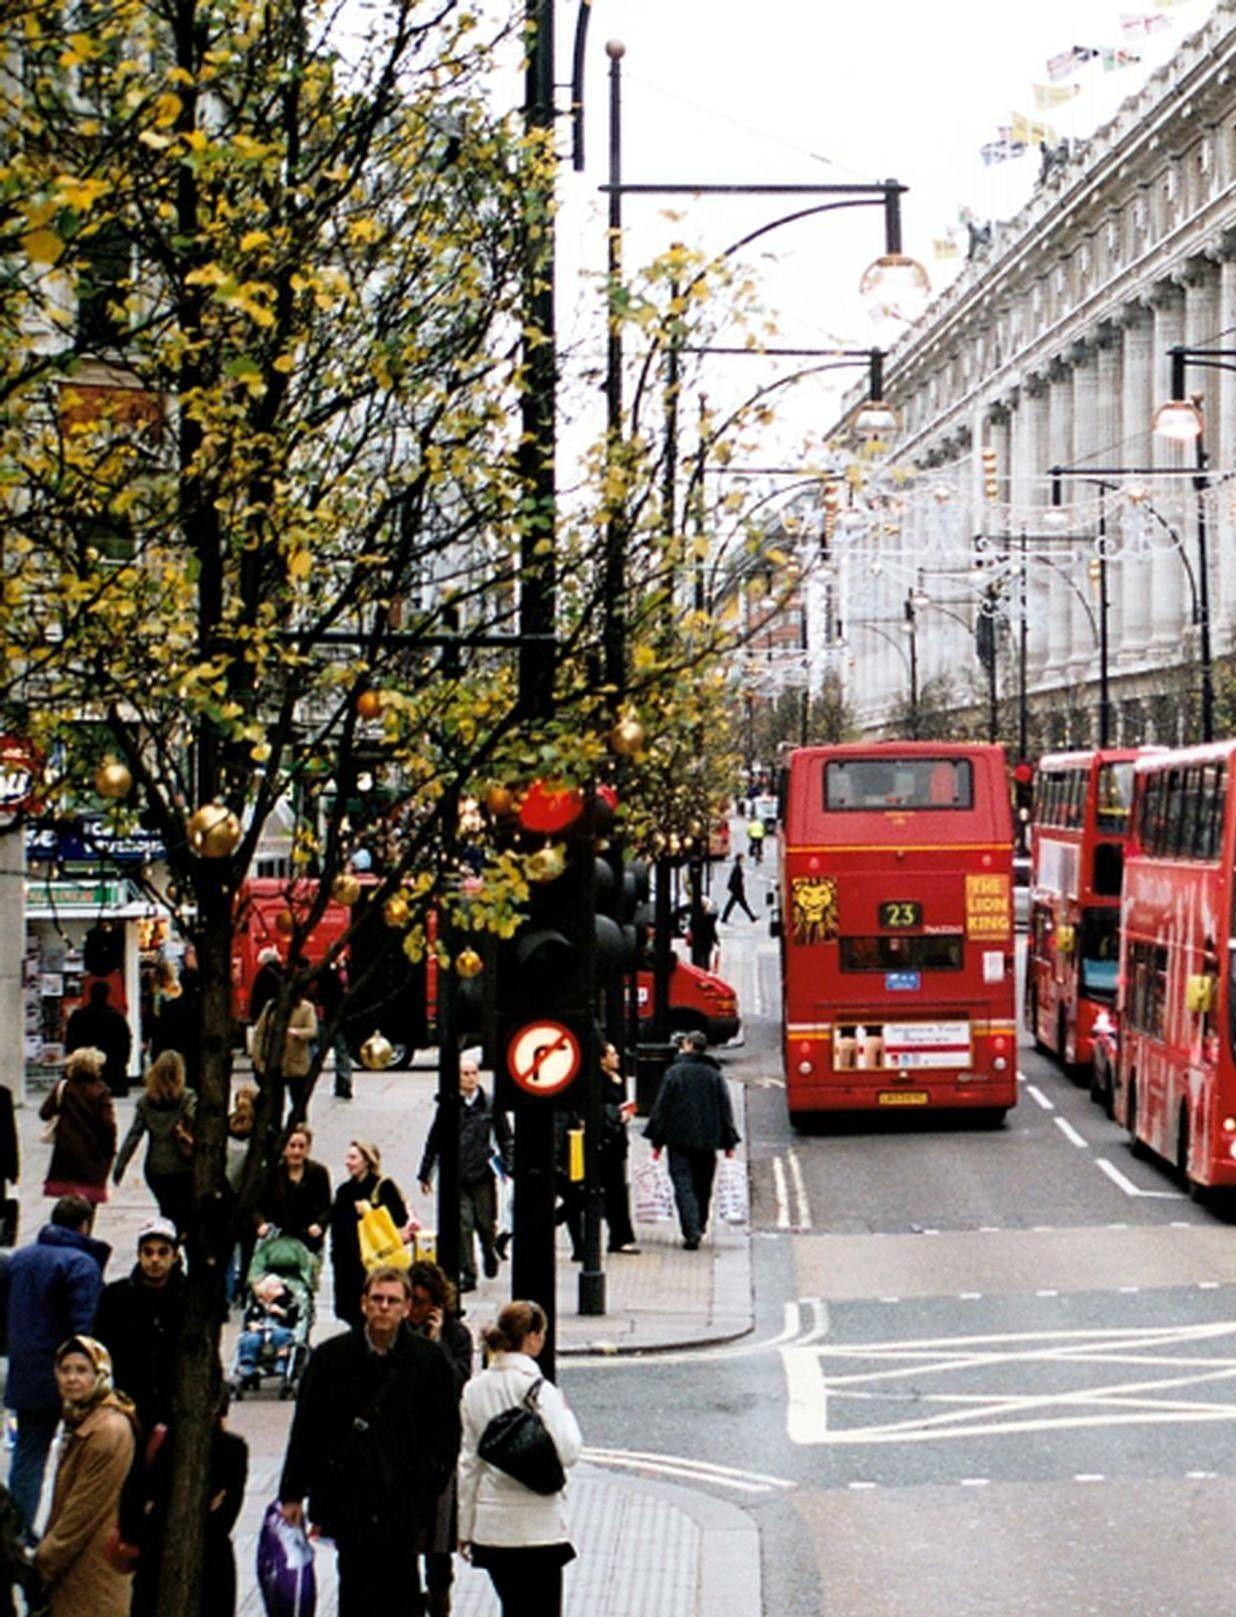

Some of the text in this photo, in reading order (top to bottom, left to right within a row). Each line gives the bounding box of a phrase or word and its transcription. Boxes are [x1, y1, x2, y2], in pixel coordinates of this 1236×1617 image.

[969, 879, 1001, 894] THE
[968, 896, 1009, 913] LION
[887, 904, 915, 926] 23
[967, 915, 1010, 931] KING
